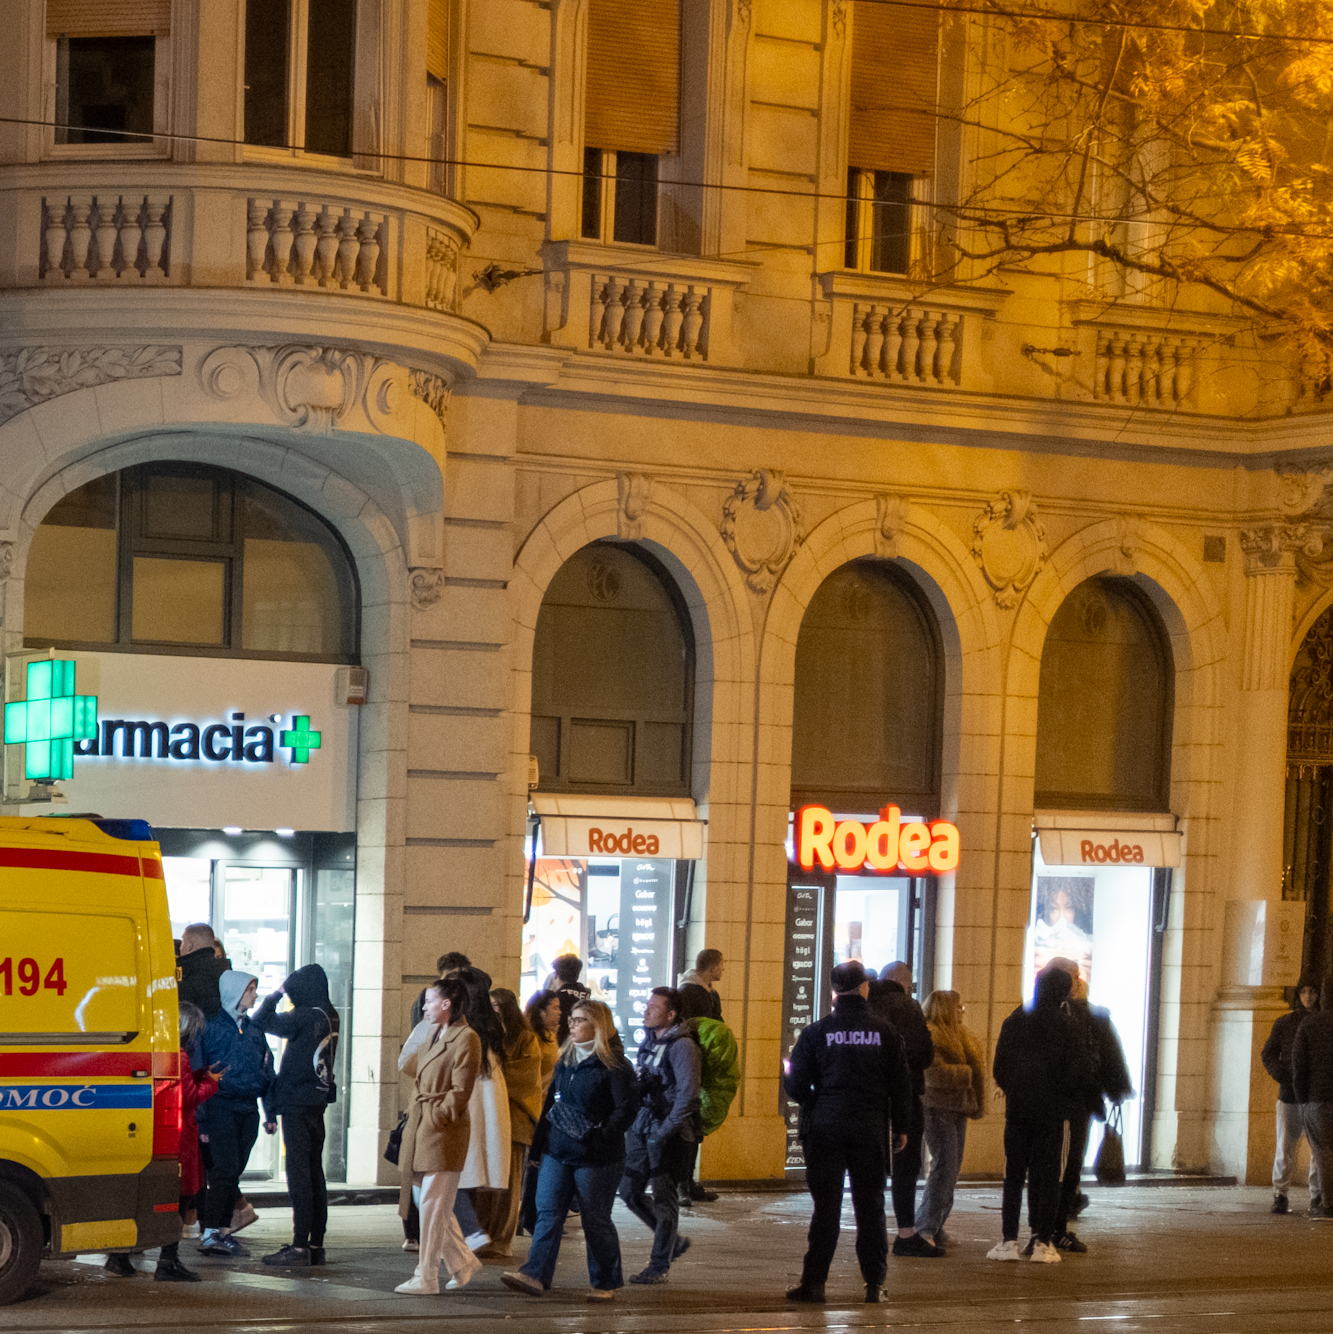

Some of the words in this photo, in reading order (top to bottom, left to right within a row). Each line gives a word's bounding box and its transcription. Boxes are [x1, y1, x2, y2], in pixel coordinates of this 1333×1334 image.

[588, 827, 660, 855] Rodea
[797, 803, 961, 876] Rodea
[1080, 838, 1145, 864] Rodea
[826, 1030, 882, 1047] POLICIJA
